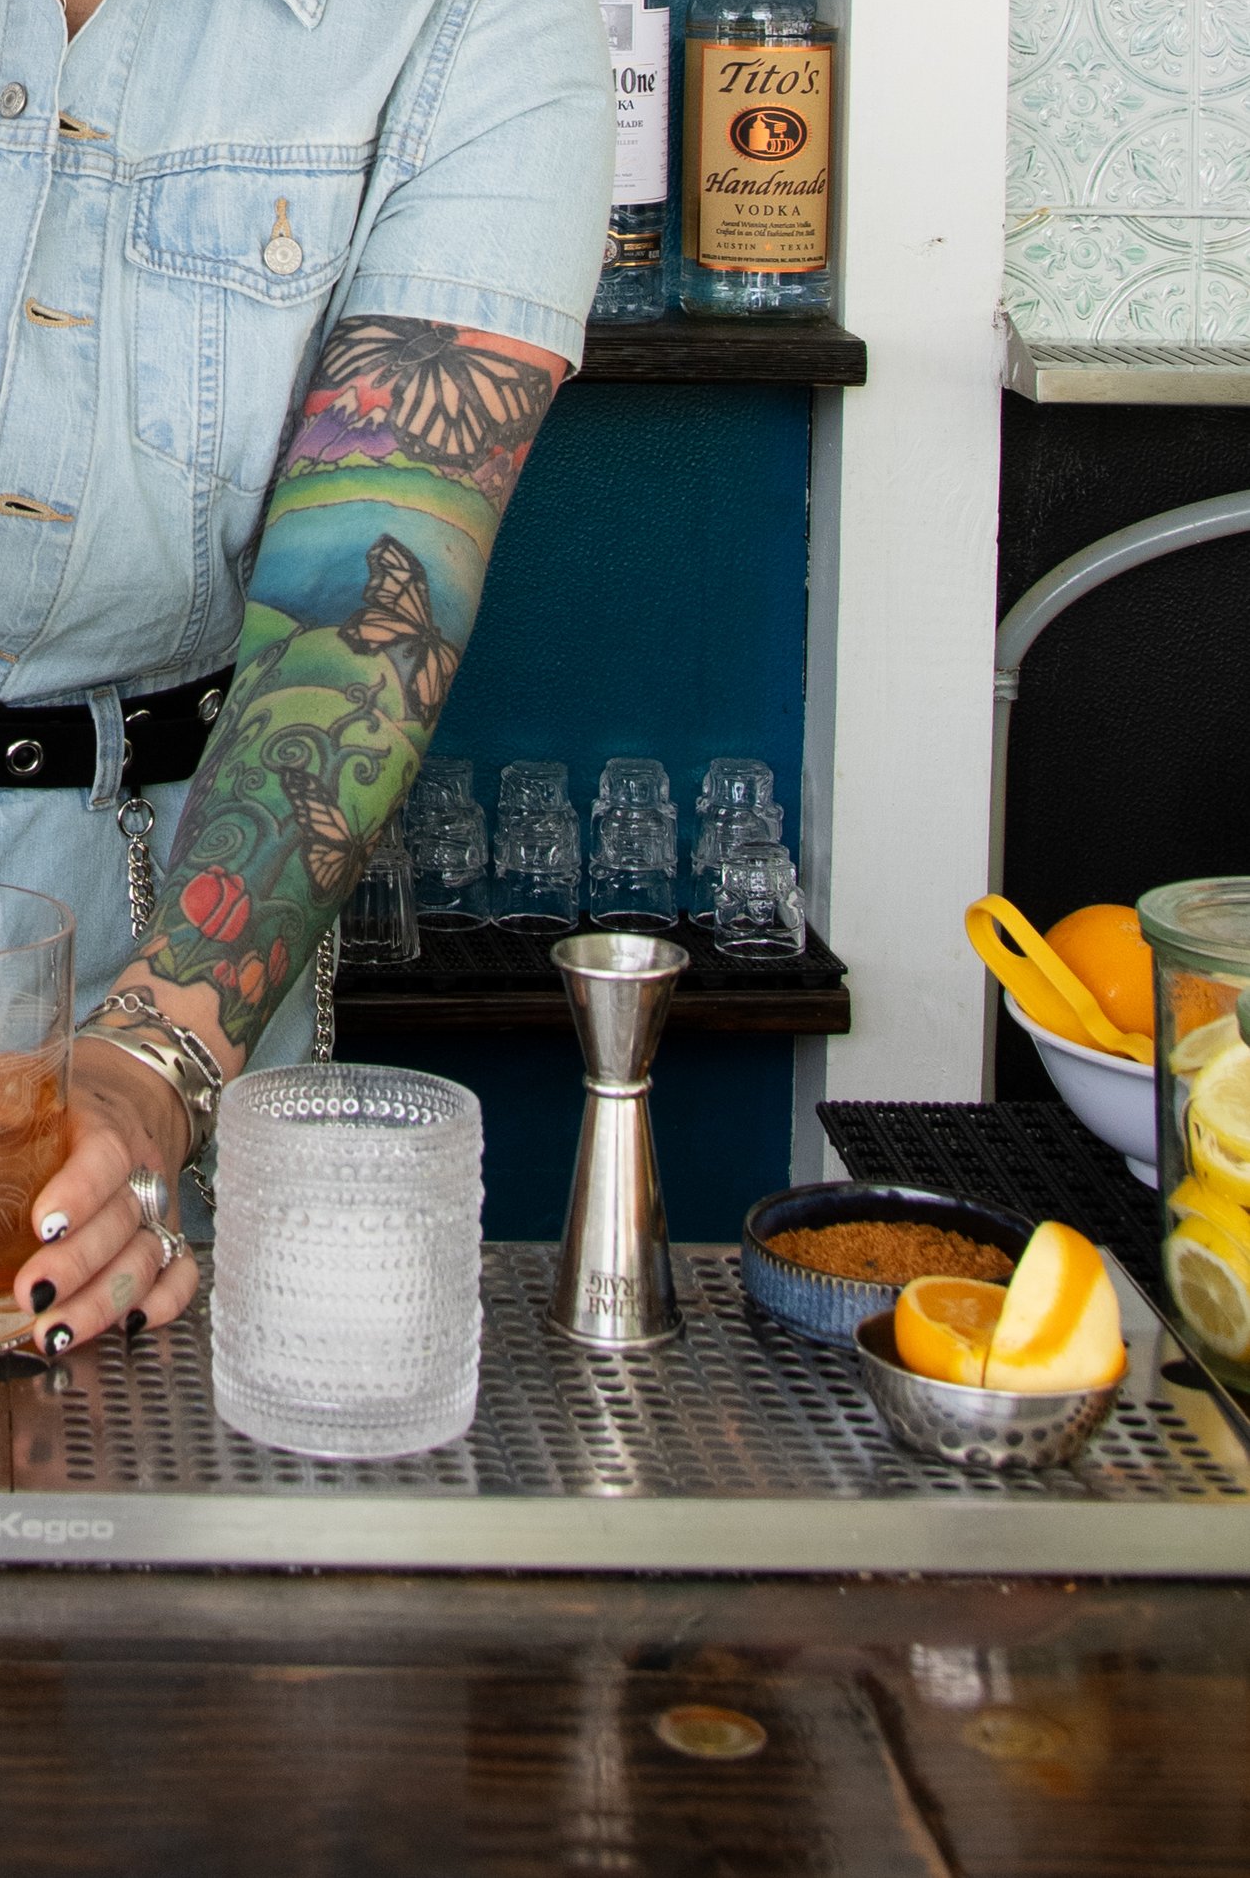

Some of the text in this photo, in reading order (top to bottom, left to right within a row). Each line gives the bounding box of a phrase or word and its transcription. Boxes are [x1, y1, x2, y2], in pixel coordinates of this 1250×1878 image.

[620, 67, 656, 94] One
[705, 167, 827, 196] Handmade
[735, 203, 801, 216] VODKA
[716, 228, 736, 237] Crafted
[754, 229, 765, 237] Old
[767, 229, 795, 238] Fashioned
[741, 221, 767, 229] Winning
[770, 221, 796, 229] American
[716, 242, 815, 251] AUSTIN TEXAS
[589, 1274, 635, 1296] RAIG
[589, 1296, 635, 1317] LIJAH
